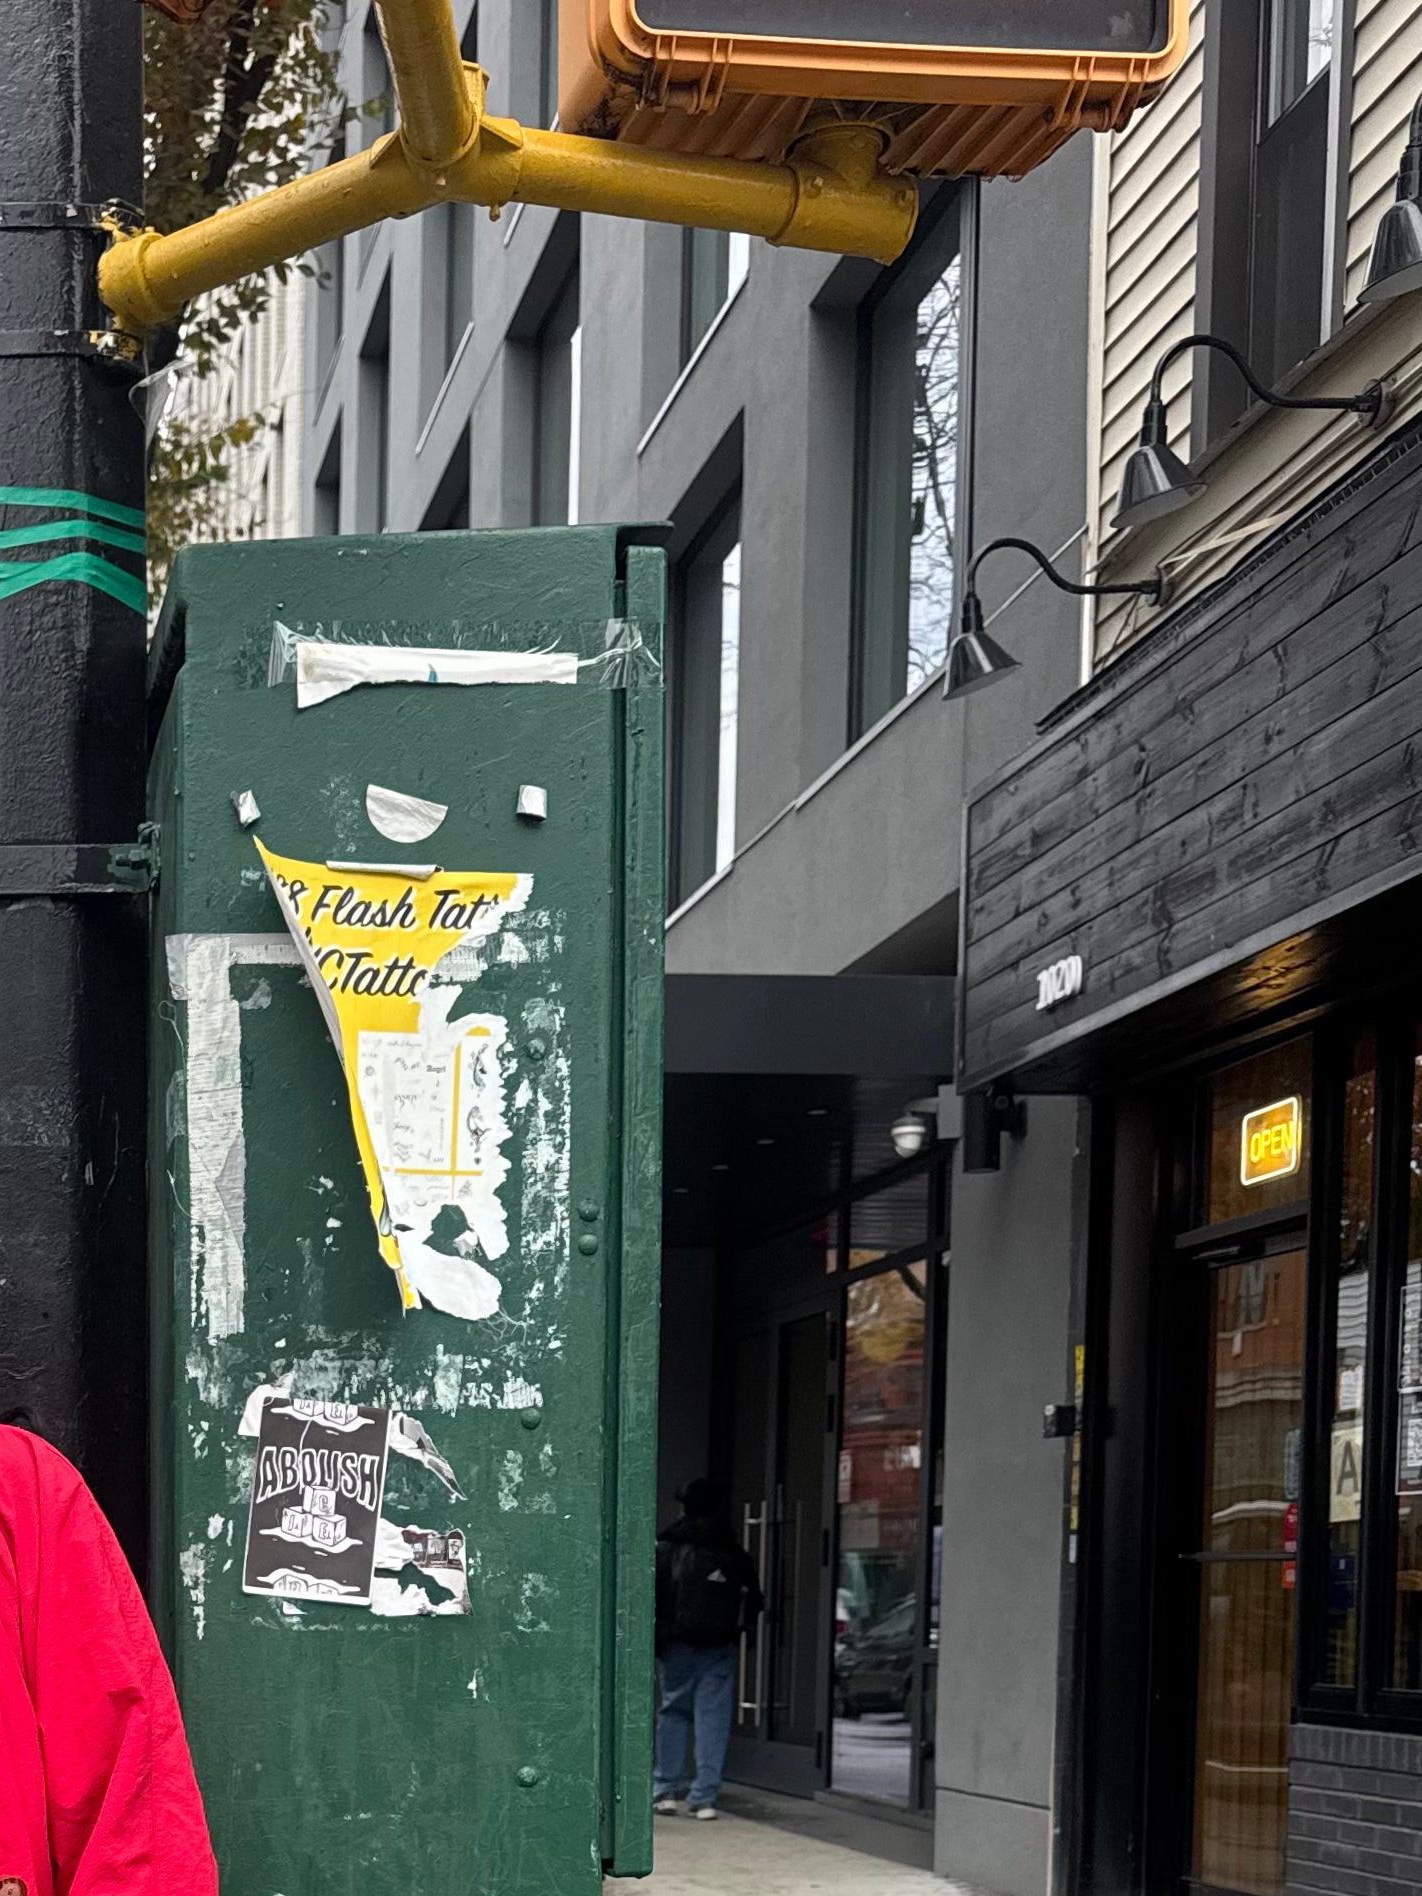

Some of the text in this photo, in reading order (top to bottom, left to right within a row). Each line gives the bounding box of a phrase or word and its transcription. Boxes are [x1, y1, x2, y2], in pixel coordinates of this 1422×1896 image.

[311, 885, 416, 928] Flash
[1250, 1121, 1295, 1163] OPEN
[256, 1446, 380, 1511] ABOLISH
[1336, 1439, 1359, 1495] A
